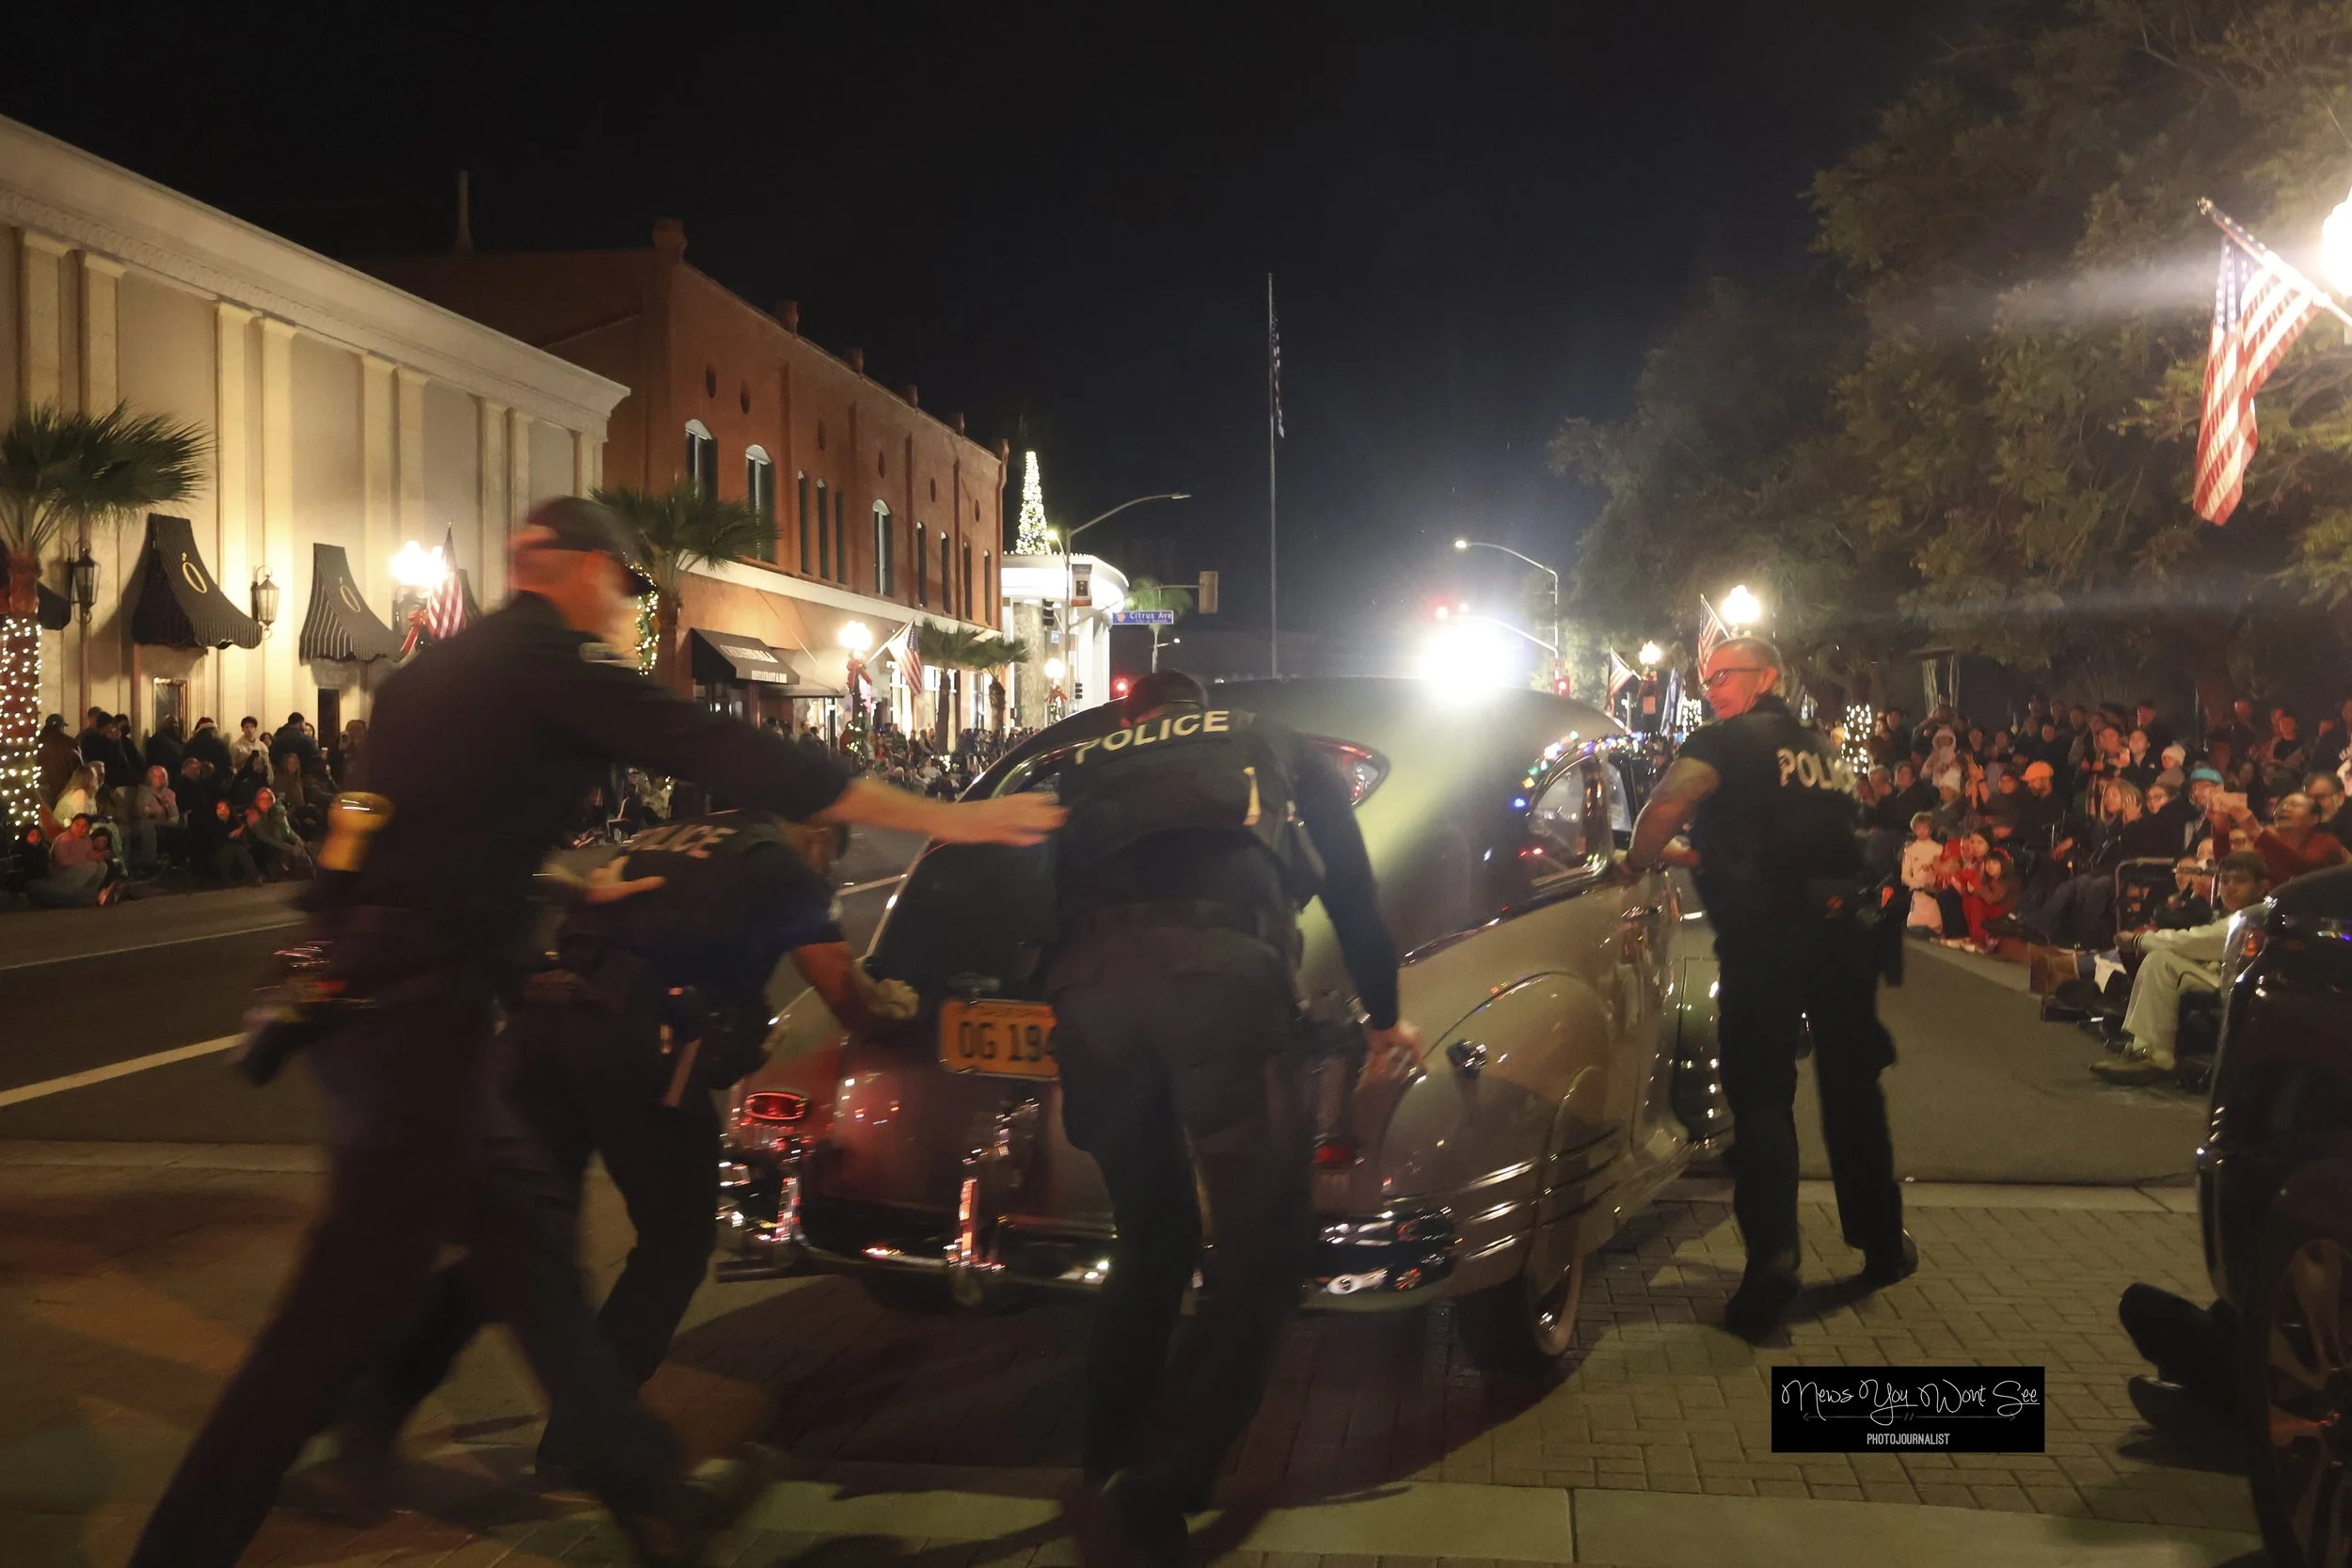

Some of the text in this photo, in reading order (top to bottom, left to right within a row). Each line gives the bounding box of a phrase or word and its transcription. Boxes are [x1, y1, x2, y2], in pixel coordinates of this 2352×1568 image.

[1129, 610, 1173, 620] Citrus Ave
[1074, 710, 1231, 766] POLICE
